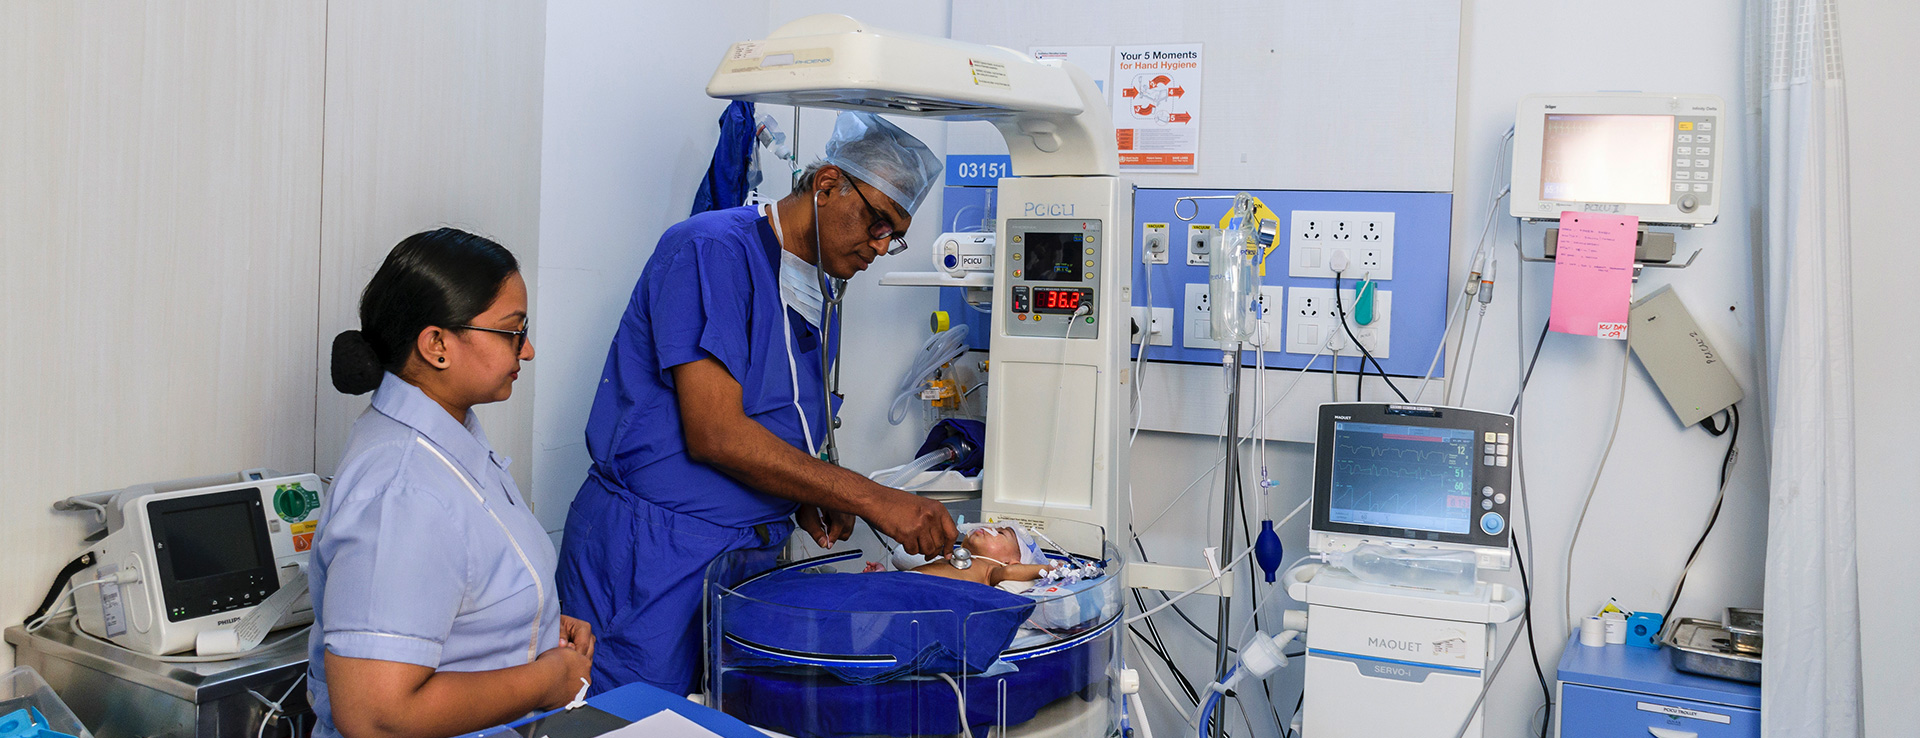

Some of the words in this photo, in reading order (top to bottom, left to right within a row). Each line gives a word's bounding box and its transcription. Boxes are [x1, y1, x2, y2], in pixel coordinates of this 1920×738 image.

[1120, 52, 1142, 60] Your
[1144, 51, 1150, 60] 5
[1152, 51, 1197, 60] Moments
[1120, 62, 1132, 70] for
[1135, 61, 1158, 70] Hand
[1160, 60, 1197, 71] Hygiene
[1170, 114, 1176, 122] 5
[958, 162, 1006, 178] 03151
[1024, 202, 1075, 217] PCICU
[1047, 290, 1080, 309] 36.2
[1457, 446, 1465, 455] 12
[1455, 469, 1464, 478] 51
[1454, 482, 1464, 491] 60
[1368, 636, 1422, 653] MAQUET
[1373, 665, 1411, 677] SERVO-i
